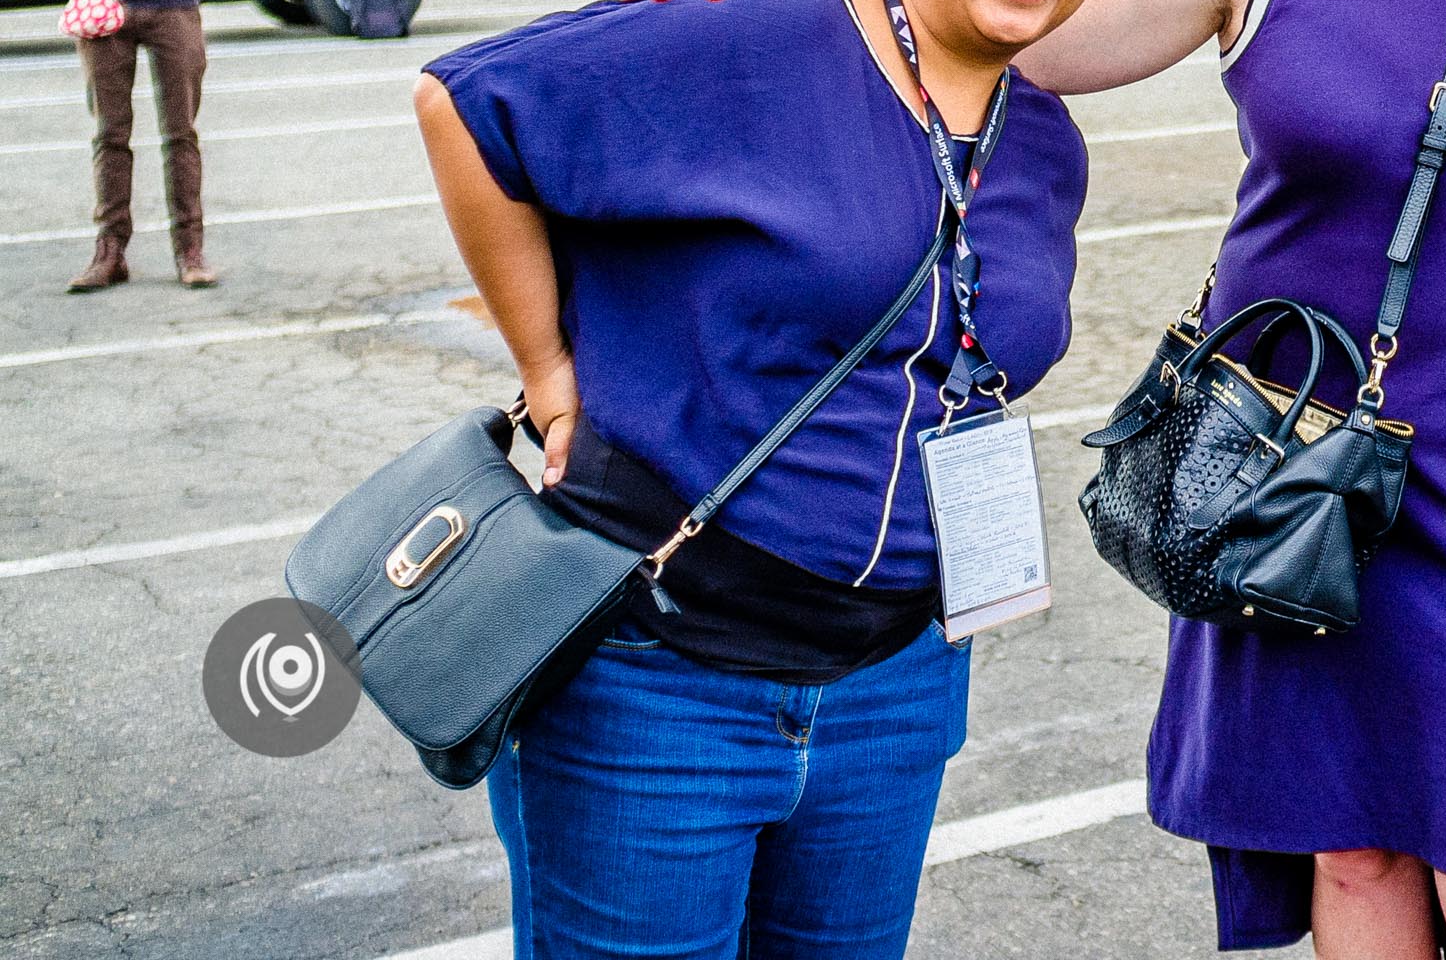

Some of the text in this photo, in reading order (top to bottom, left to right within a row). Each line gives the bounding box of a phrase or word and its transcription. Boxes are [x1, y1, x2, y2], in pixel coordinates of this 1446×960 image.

[980, 89, 1005, 154] Microsoft Surface
[933, 122, 962, 201] Microsoft Surface
